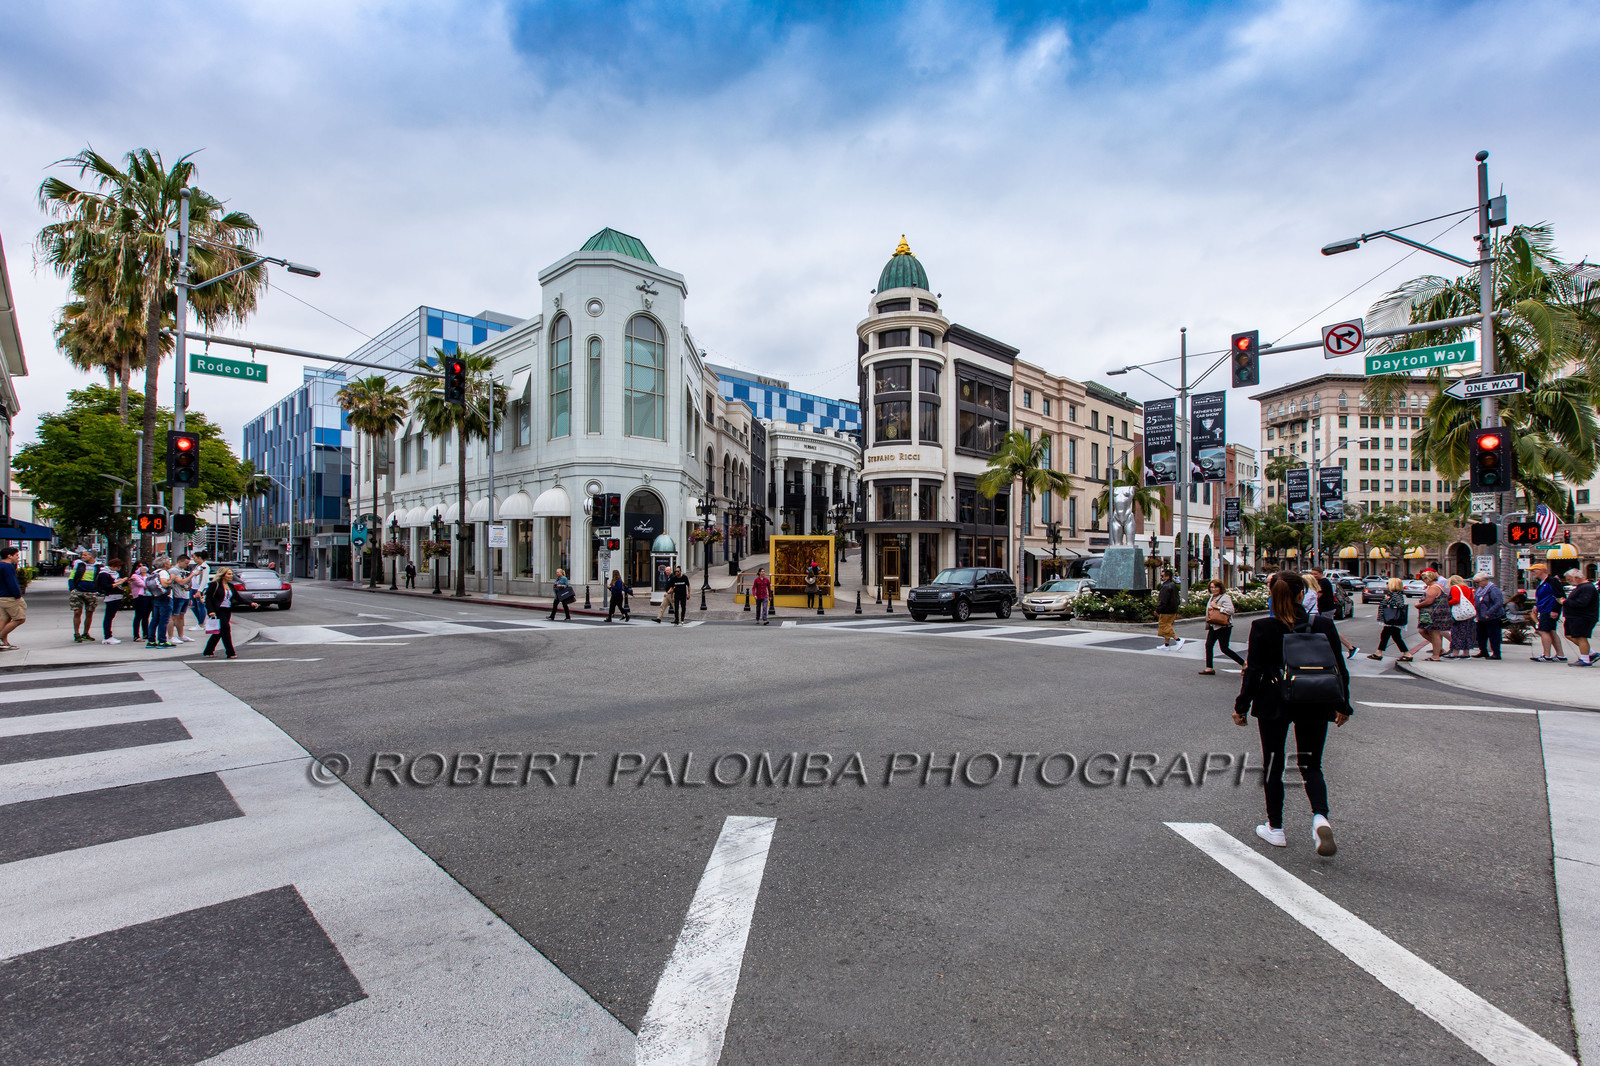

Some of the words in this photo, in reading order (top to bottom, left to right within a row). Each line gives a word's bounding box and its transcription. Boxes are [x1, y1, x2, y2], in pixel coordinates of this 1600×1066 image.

[1372, 354, 1428, 371] Dayton
[1434, 349, 1467, 361] Way
[197, 359, 240, 375] Rodeo
[246, 366, 262, 378] Dr
[1466, 383, 1488, 393] ONE
[1491, 379, 1515, 389] WAY
[899, 452, 921, 461] RICCI
[1472, 503, 1482, 511] OK
[154, 517, 162, 530] 19
[1528, 526, 1538, 540] 19
